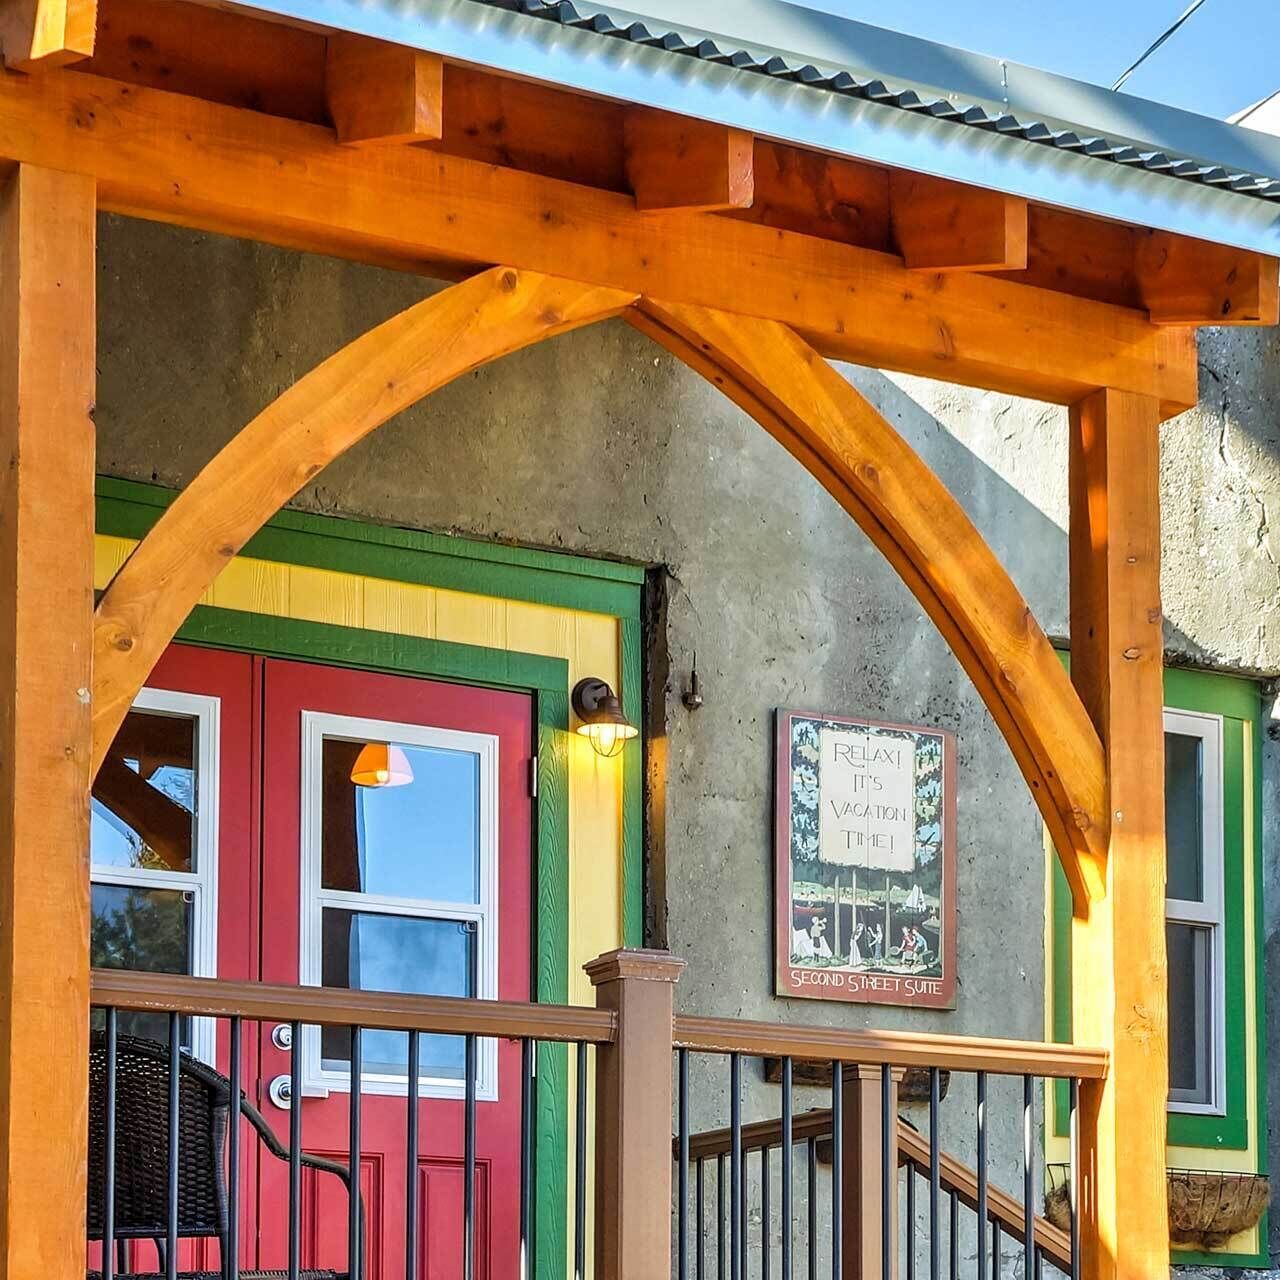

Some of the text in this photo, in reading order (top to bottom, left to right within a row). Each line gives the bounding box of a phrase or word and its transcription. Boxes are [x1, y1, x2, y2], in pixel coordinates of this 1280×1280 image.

[834, 743, 901, 769] RELAX!
[854, 773, 883, 793] IT'S
[830, 800, 907, 821] VACATION
[840, 828, 895, 854] TIME!
[790, 969, 944, 997] SECOND STREET SUITE
